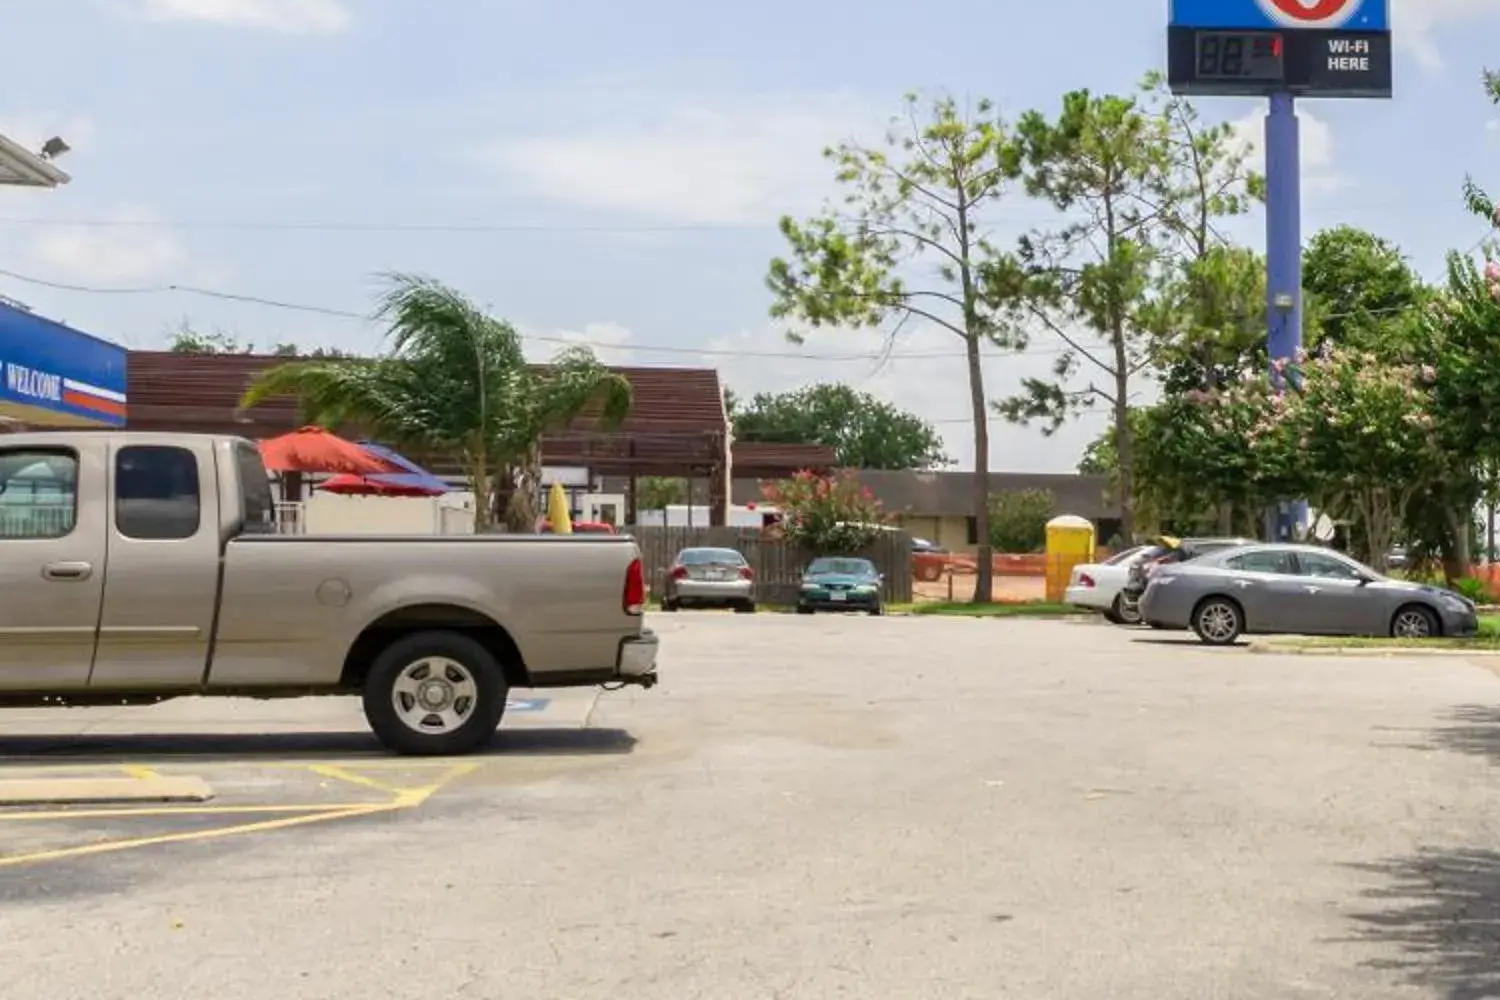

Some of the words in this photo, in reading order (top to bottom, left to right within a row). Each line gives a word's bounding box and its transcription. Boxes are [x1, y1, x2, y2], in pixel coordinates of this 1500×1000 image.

[1327, 39, 1369, 54] WI-FI
[1327, 56, 1369, 71] HERE
[7, 363, 61, 401] WELCOME
